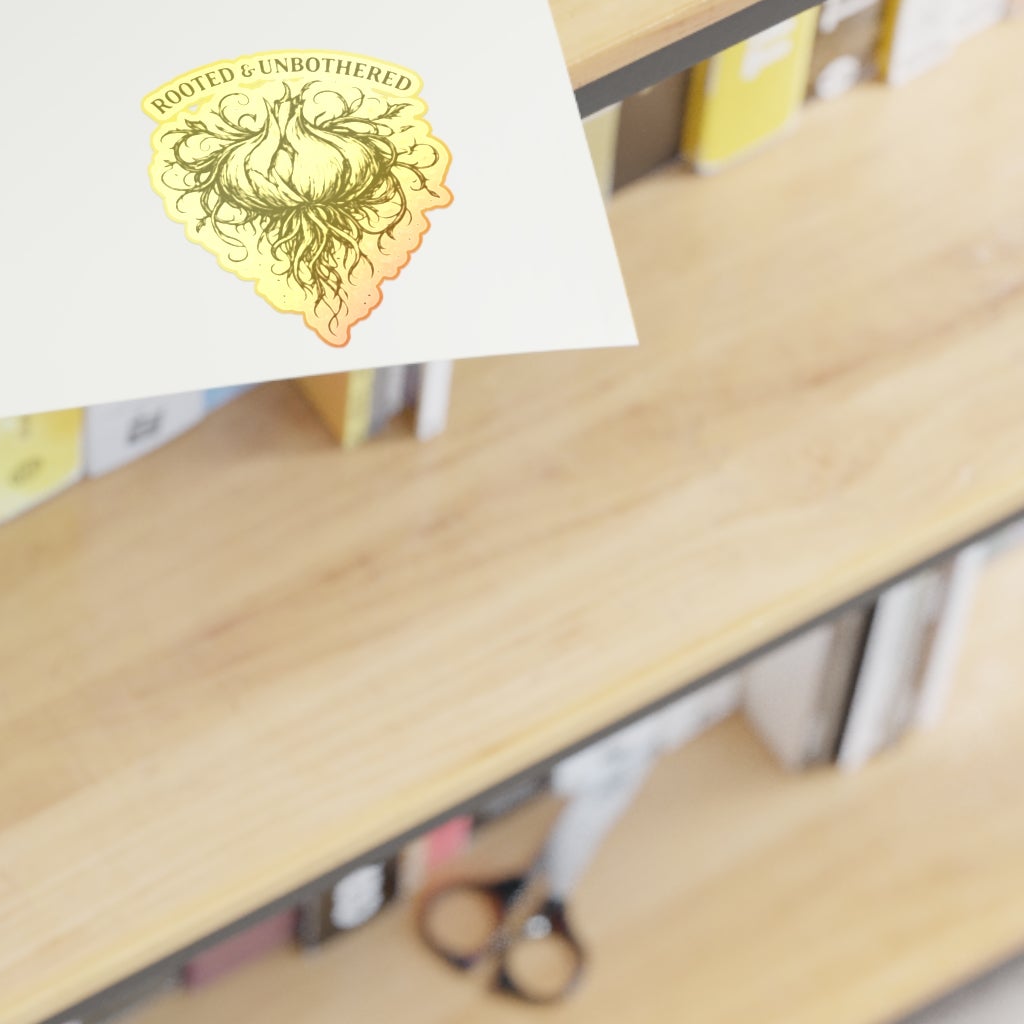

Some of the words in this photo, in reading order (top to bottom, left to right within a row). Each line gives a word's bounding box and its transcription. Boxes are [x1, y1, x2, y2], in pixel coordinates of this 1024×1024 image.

[150, 67, 235, 115] ROOTED
[240, 63, 256, 78] &
[258, 57, 413, 92] UNBOTHERED
